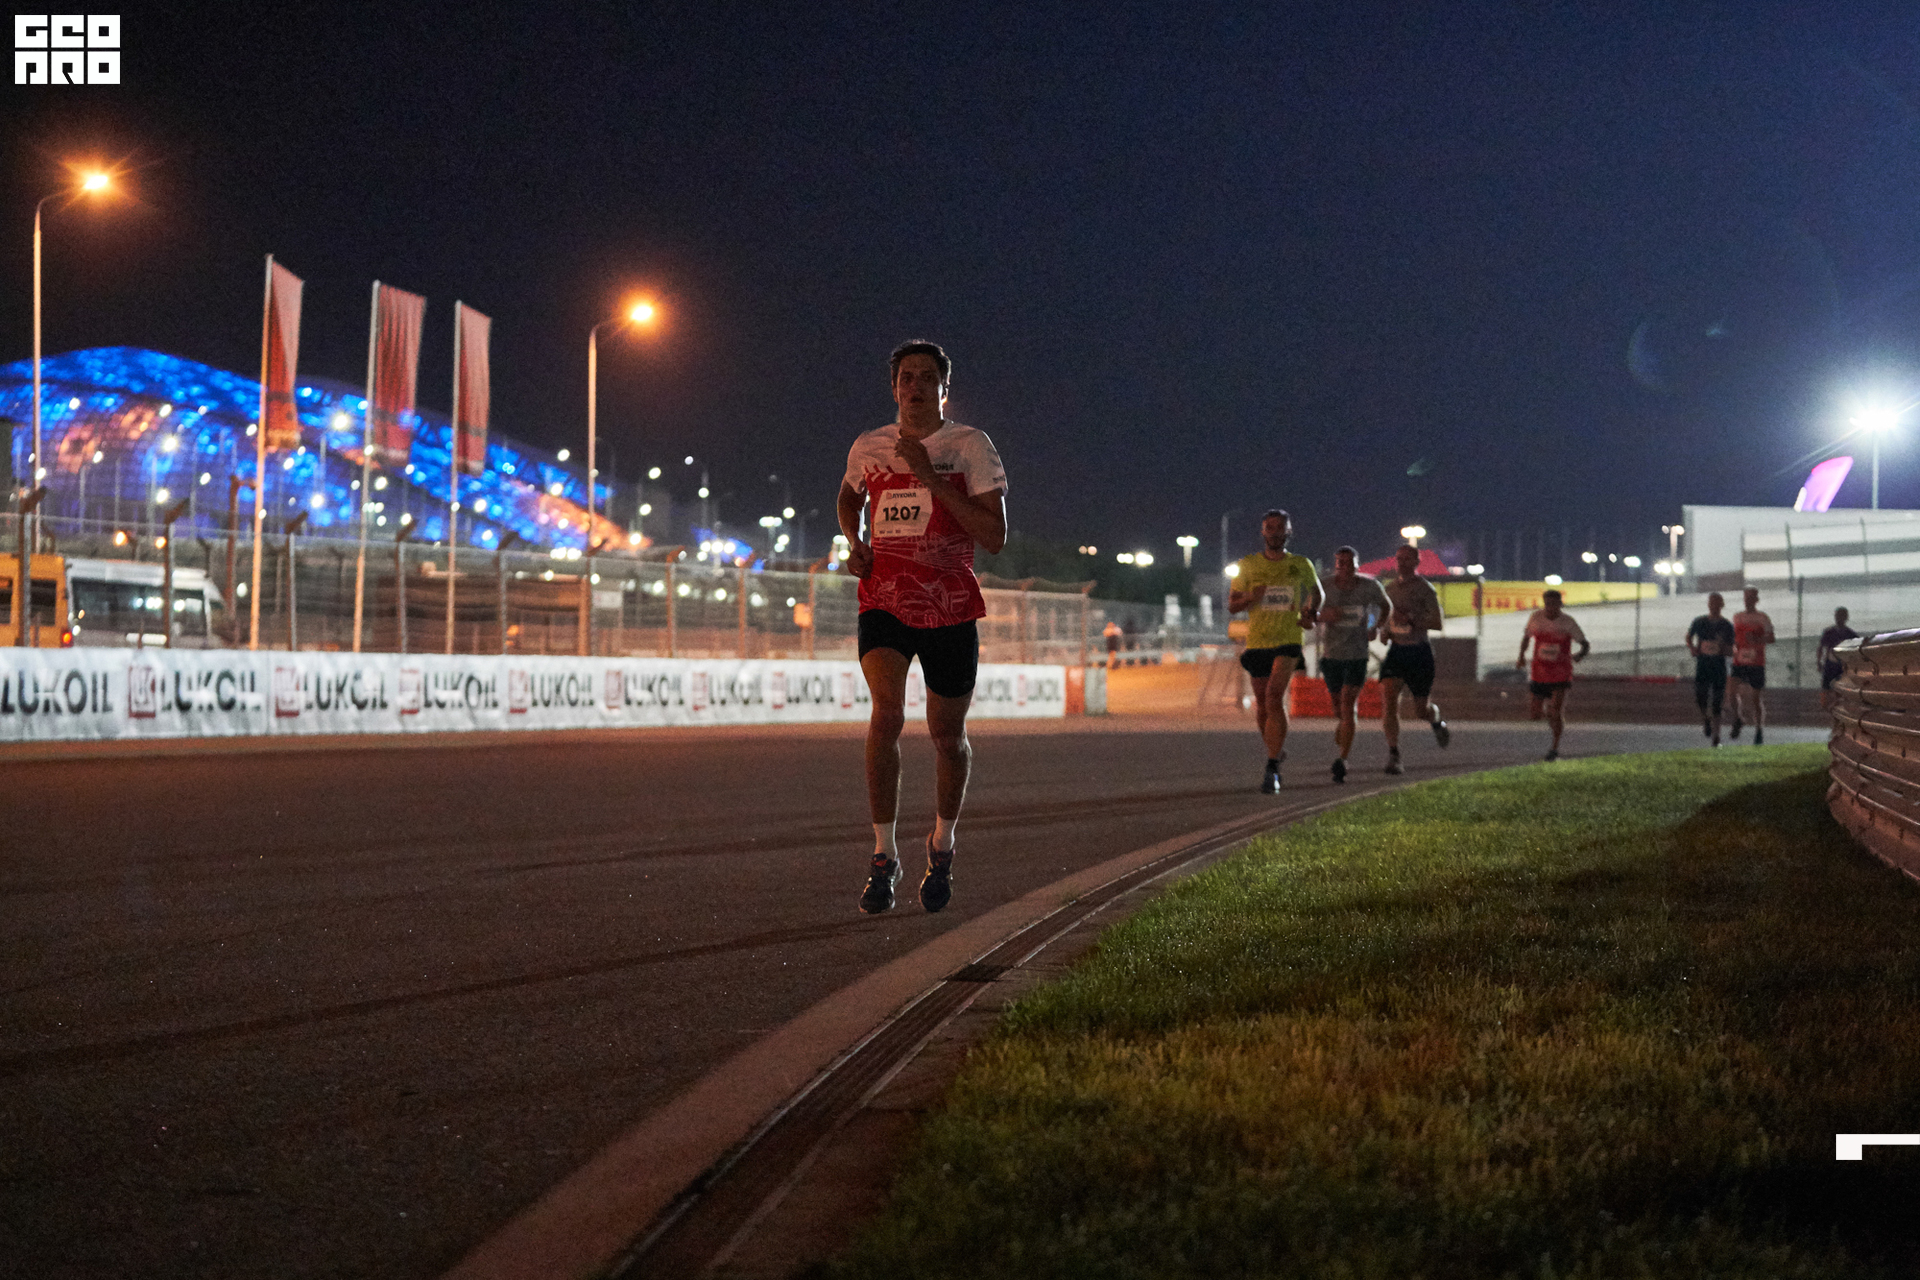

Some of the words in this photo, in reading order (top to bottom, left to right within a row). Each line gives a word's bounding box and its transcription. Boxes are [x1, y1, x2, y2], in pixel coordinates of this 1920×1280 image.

[883, 506, 921, 521] 1207
[0, 669, 113, 714] LUKOIL
[161, 670, 261, 712] LUKOIL
[304, 671, 388, 710] LUKOIL
[424, 672, 498, 709] LUKOIL
[530, 673, 594, 708] LUKOIL
[624, 674, 684, 706] LUKOIL
